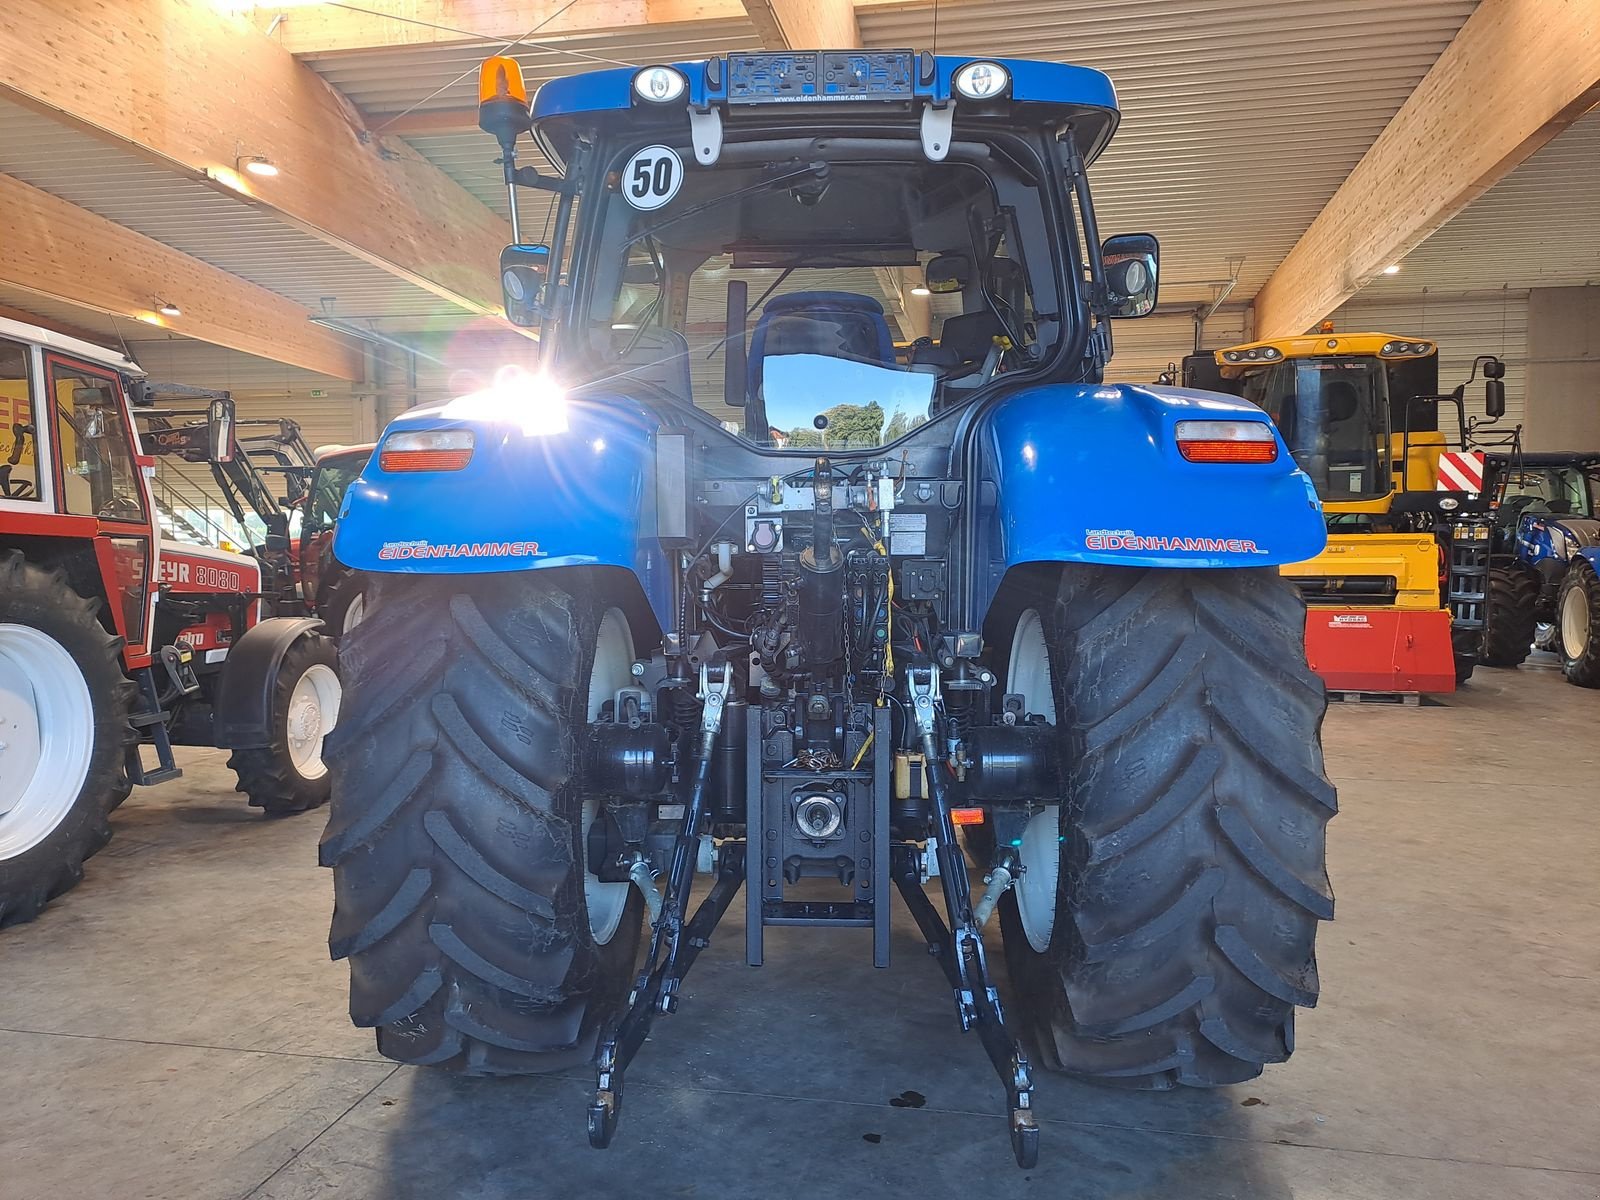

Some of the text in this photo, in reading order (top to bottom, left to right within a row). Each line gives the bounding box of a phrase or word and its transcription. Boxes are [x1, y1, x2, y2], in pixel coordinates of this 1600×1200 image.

[775, 94, 867, 102] www.eidenhammer.com
[631, 156, 673, 198] 50
[379, 542, 538, 559] EIDENHAMMER
[1085, 535, 1258, 553] EIDENHAMMER
[132, 559, 239, 591] SEYR 8080
